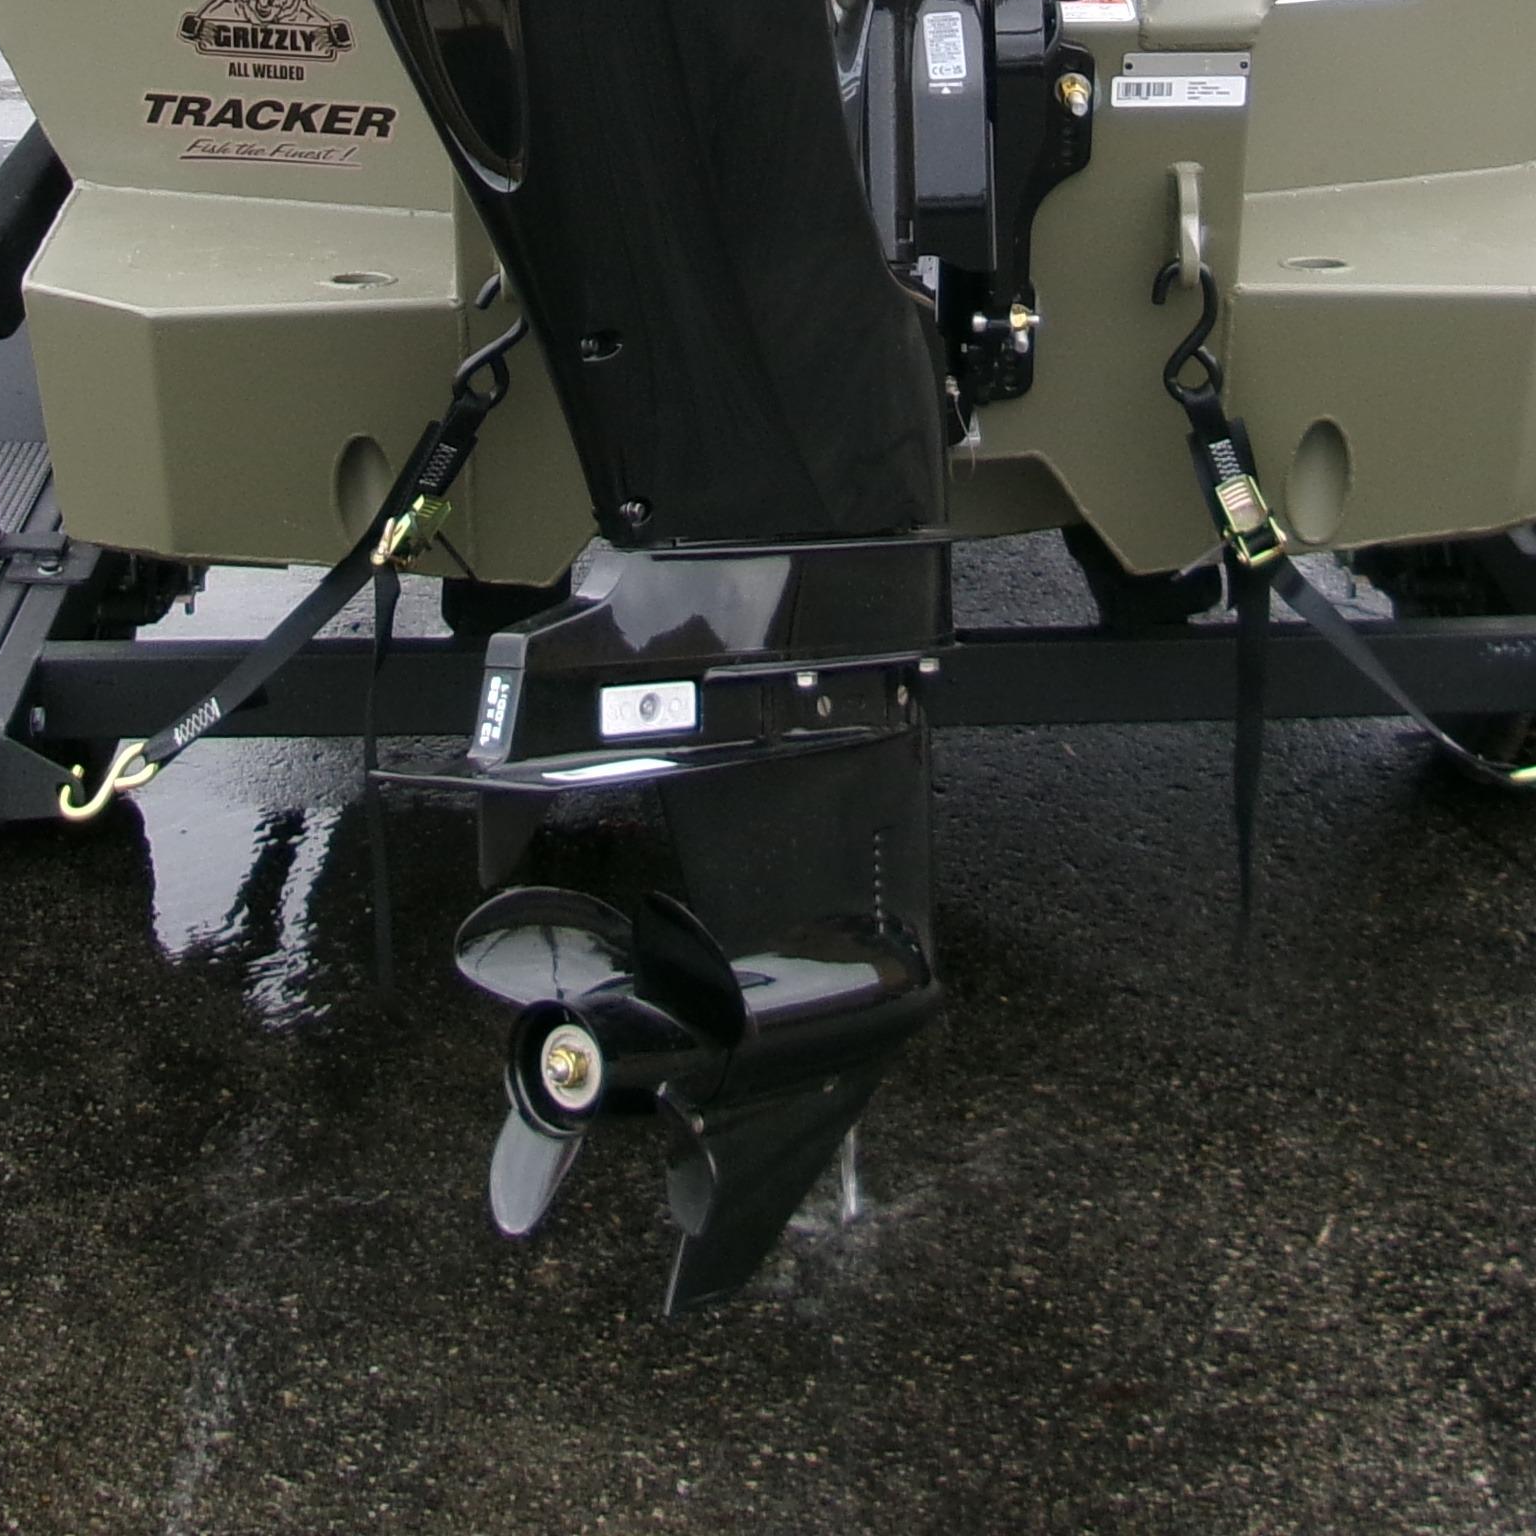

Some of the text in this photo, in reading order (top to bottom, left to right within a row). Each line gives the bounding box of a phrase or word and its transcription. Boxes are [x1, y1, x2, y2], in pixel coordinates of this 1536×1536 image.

[214, 24, 316, 52] GRIZZLY
[228, 62, 305, 81] ALL WELDED
[144, 93, 397, 138] TRACKER
[186, 138, 229, 154] Fish
[235, 142, 265, 156] the
[270, 143, 338, 160] Finest
